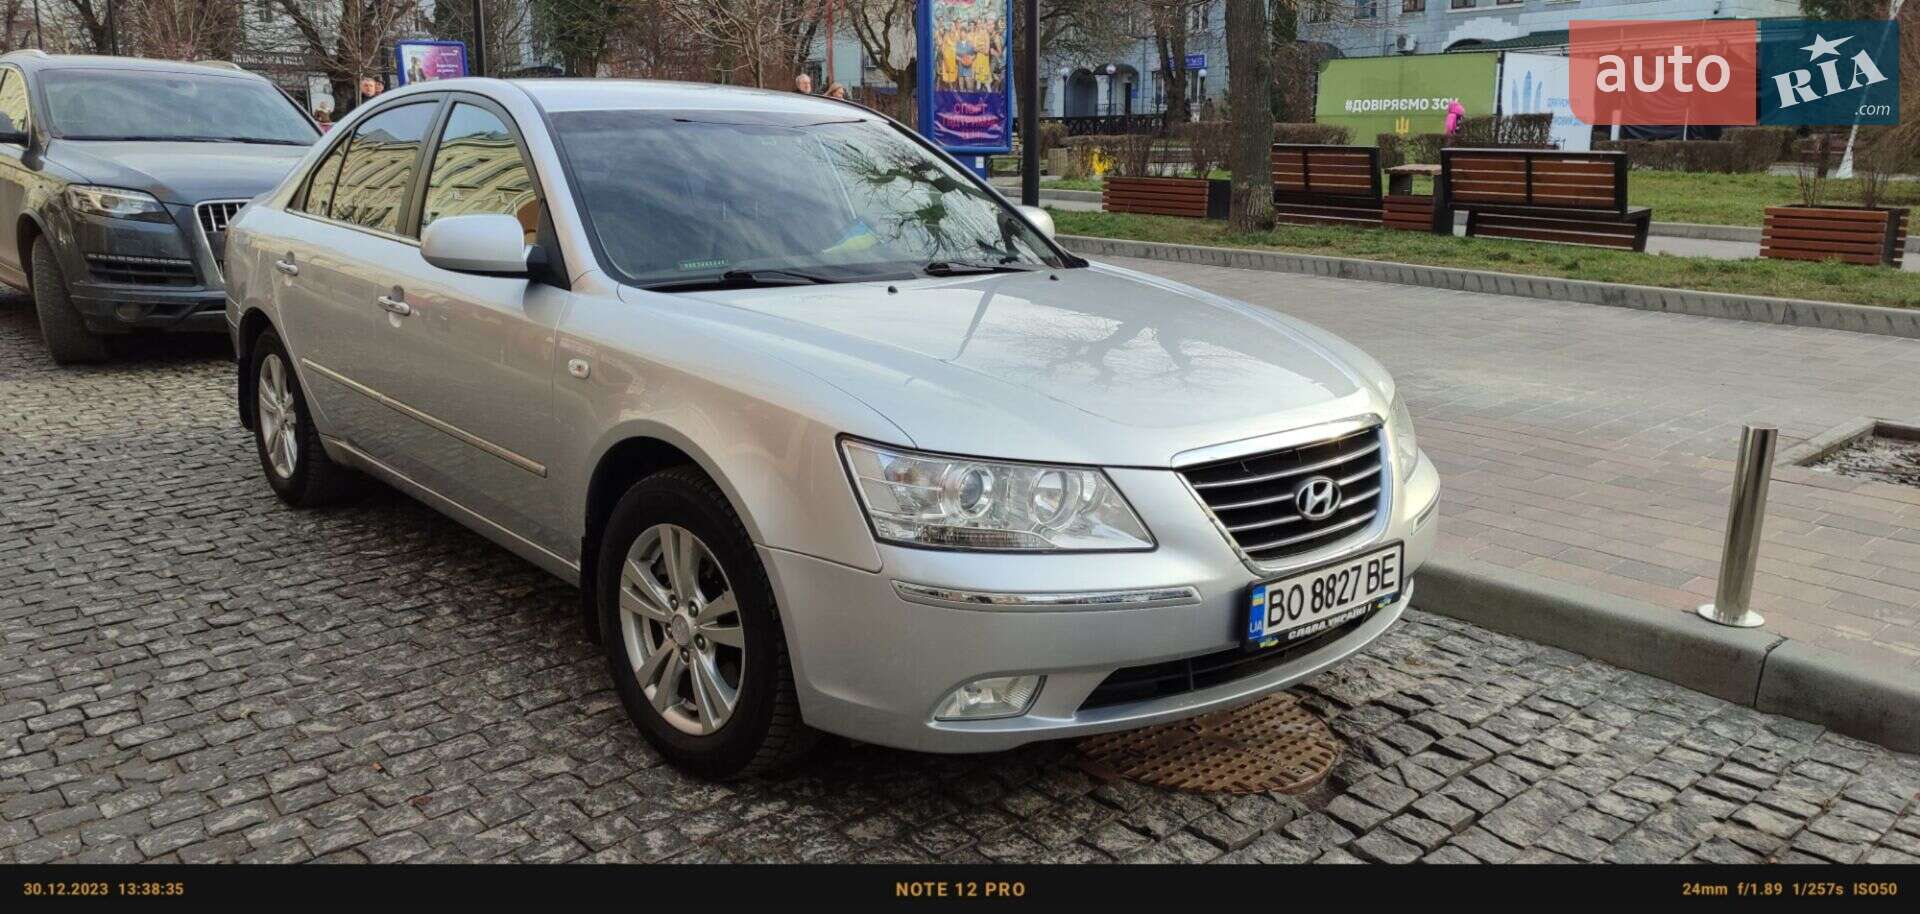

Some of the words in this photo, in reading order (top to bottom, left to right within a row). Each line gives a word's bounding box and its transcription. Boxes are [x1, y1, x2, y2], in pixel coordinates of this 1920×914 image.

[1344, 98, 1429, 112] #ДОВІРЯЄМО
[1267, 584, 1305, 627] BO
[1310, 564, 1362, 614] 8827
[1366, 552, 1396, 595] BE
[1249, 621, 1263, 635] UA
